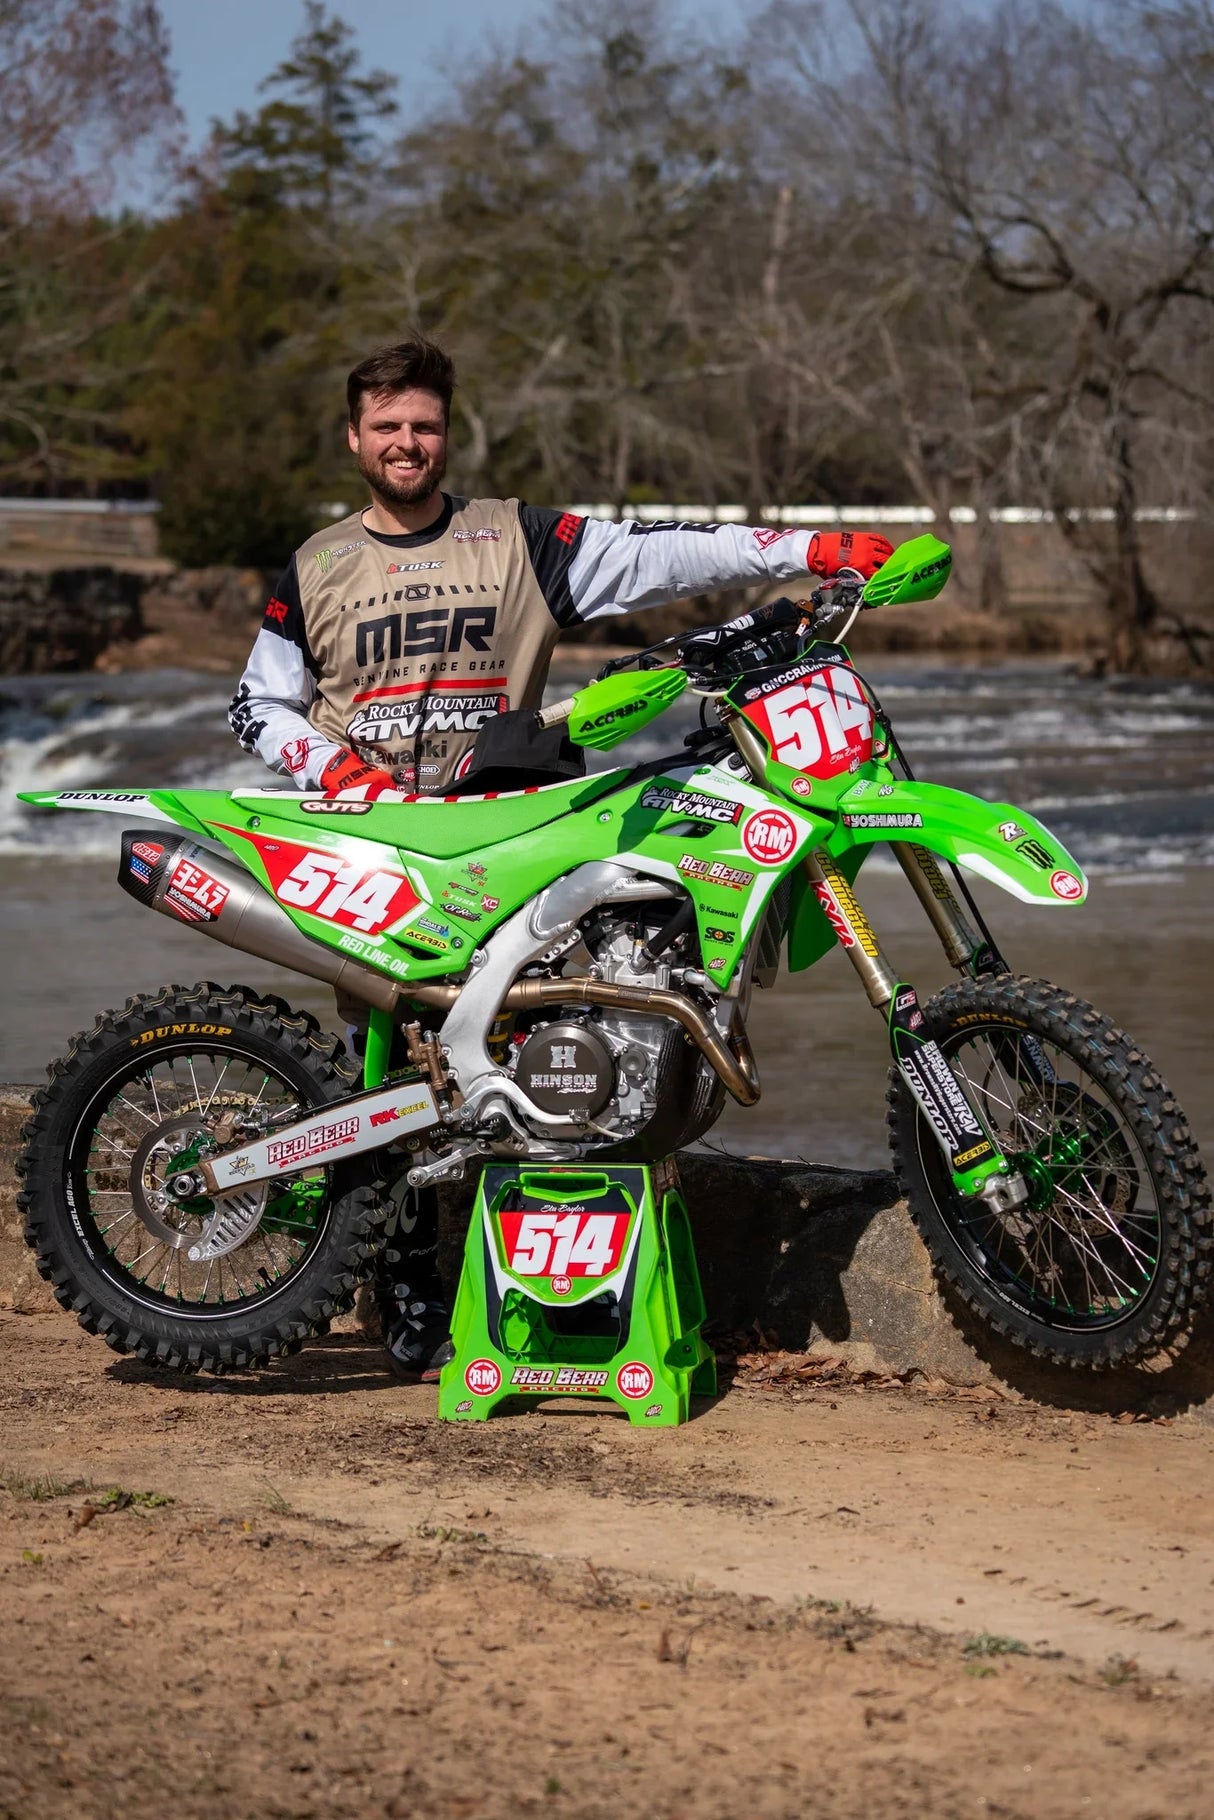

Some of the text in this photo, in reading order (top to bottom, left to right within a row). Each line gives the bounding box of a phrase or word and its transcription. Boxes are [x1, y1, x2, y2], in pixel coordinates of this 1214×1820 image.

[400, 560, 445, 573] TUSK
[355, 606, 498, 668] MSR
[419, 662, 459, 674] RACE
[469, 660, 506, 671] GEAR
[367, 695, 498, 721] ROCKY MOUNTAIN
[579, 699, 649, 733] ACERBIS
[763, 666, 872, 771] 514
[338, 766, 373, 790] MSR
[56, 792, 147, 803] DUNLOP
[302, 801, 371, 813] GUTS
[659, 788, 739, 812] ROCKY MOUNTAIN
[850, 813, 923, 828] YOSHIMURA
[678, 855, 754, 886] RED BEAR
[688, 872, 735, 888] RACING
[167, 886, 212, 920] YOSHIMURA
[276, 851, 404, 932] 514
[705, 905, 739, 919] Kawasaki
[406, 930, 447, 949] ACERBIS
[704, 926, 736, 943] SOS
[337, 934, 410, 977] RED LINE OIL
[140, 1023, 232, 1044] DUNLOP
[530, 1074, 598, 1085] HINSON
[920, 1045, 960, 1107] SUPERSTORE
[369, 1101, 429, 1127] RK EXCEL
[899, 1057, 958, 1151] DUNLOP
[954, 1098, 984, 1137] RV
[267, 1117, 360, 1165] RED BEAR
[286, 1139, 345, 1164] RACING
[955, 1143, 991, 1165] ACERBIS
[70, 1208, 85, 1238] EXCEL
[511, 1214, 618, 1276] 514
[510, 1366, 610, 1386] RED BEAR
